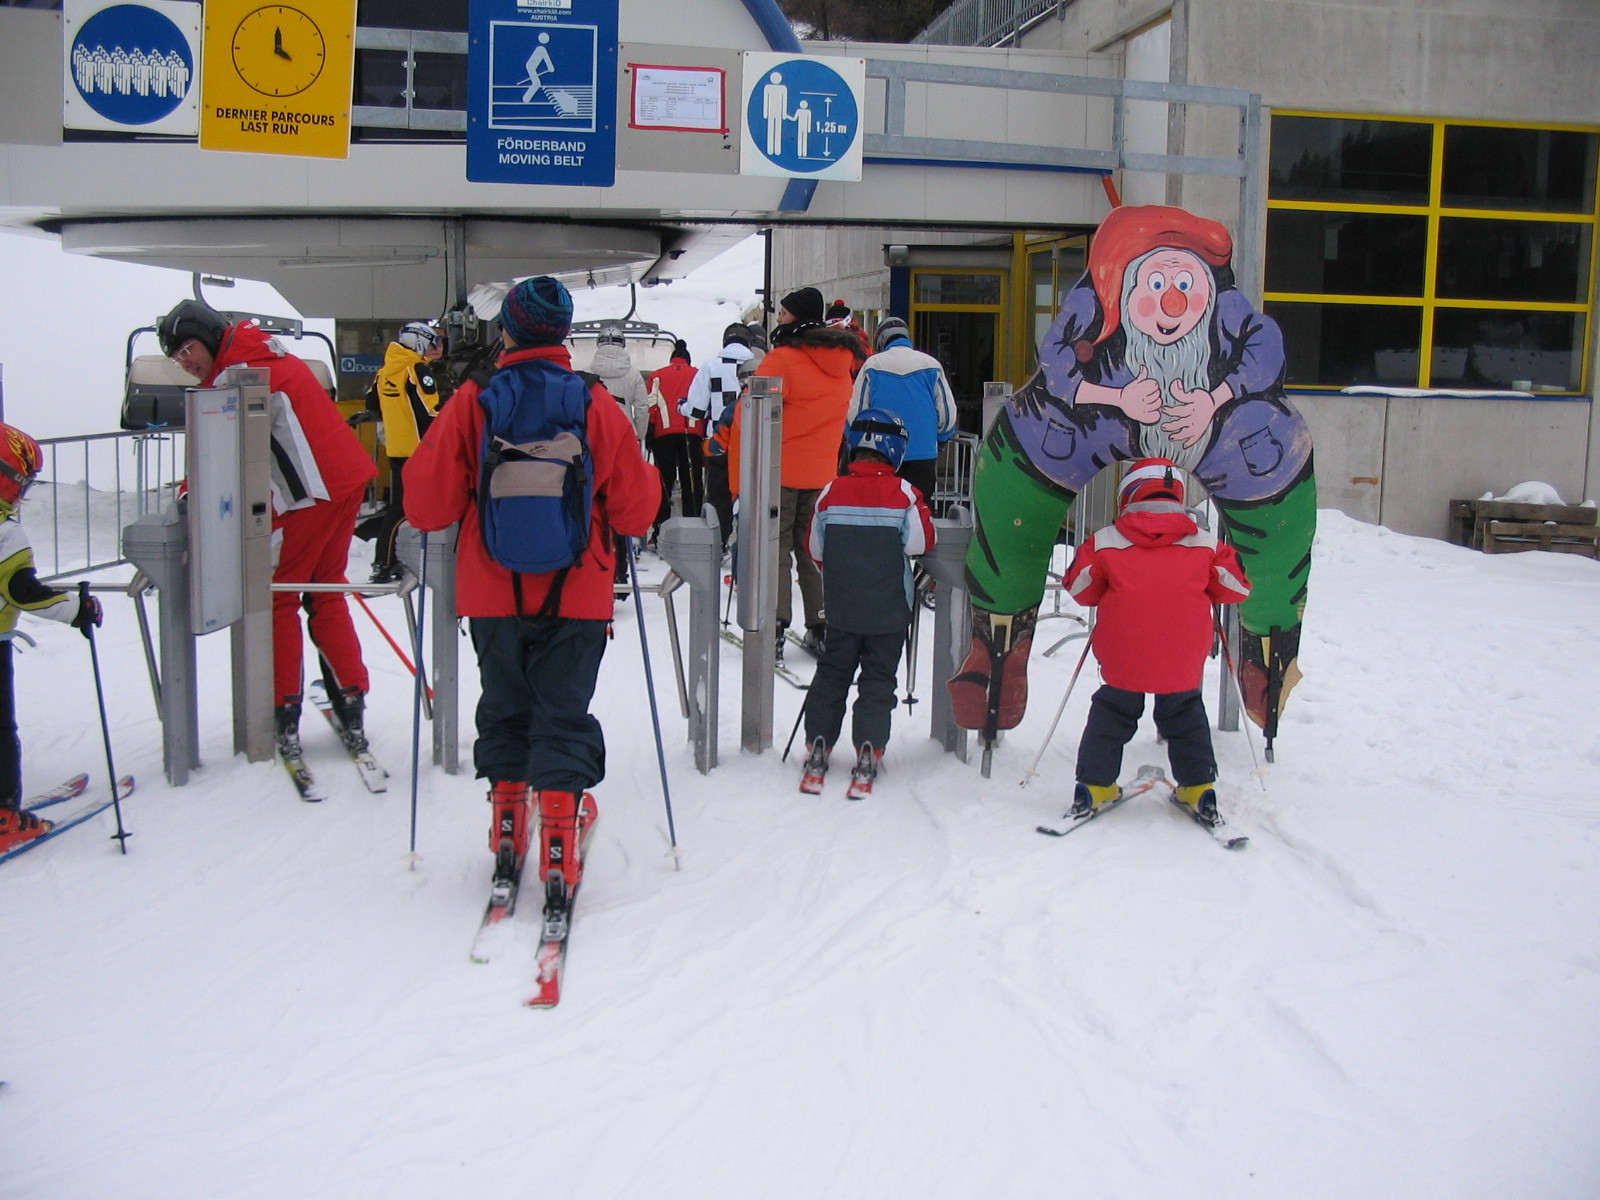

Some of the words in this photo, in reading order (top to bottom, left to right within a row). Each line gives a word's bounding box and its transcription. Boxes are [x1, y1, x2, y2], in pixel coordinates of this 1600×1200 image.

[216, 107, 268, 121] DERNIER
[271, 111, 335, 126] PARCOURS
[241, 121, 269, 133] LAST
[272, 123, 299, 135] RUN
[816, 120, 837, 134] 1,25
[837, 125, 847, 134] m
[497, 137, 587, 152] FÖRDERBAND
[499, 153, 551, 166] MOVING
[553, 155, 585, 167] BELT
